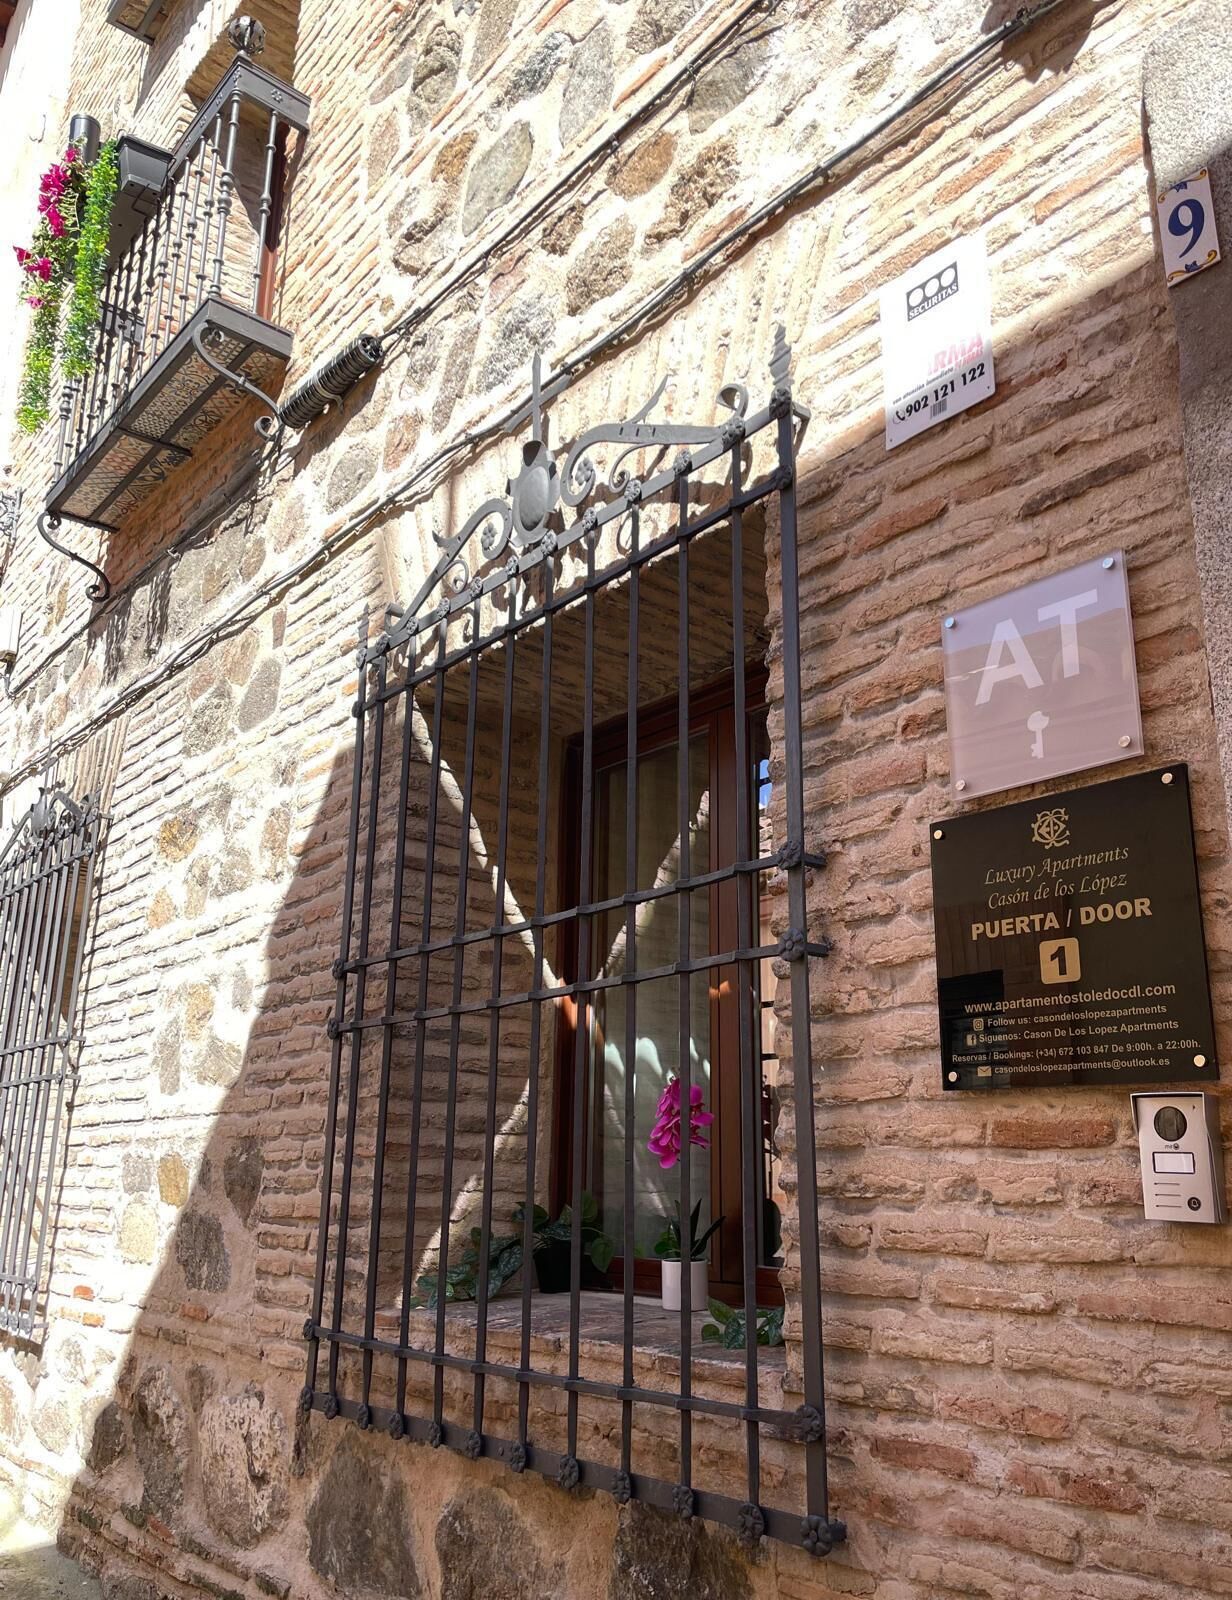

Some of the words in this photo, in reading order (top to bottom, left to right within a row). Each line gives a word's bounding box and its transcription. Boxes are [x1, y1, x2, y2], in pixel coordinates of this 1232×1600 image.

[1167, 198, 1206, 259] 9
[909, 282, 958, 319] SECURITAS
[905, 395, 929, 417] 902
[933, 379, 955, 401] 121
[961, 362, 985, 386] 122
[974, 588, 1098, 706] AT
[984, 864, 1036, 885] Luxury
[1037, 847, 1129, 878] Apartments
[988, 887, 1029, 910] Casón
[1033, 881, 1050, 900] de
[1054, 878, 1075, 897] los
[1079, 872, 1128, 895] López
[971, 911, 1060, 941] PUERTA
[1066, 908, 1072, 928] /
[1079, 897, 1153, 925] DOOR
[1050, 945, 1068, 976] 1
[964, 984, 1176, 1013] www.apartamentostoledocdl.com
[987, 1017, 1015, 1027] Follow
[1017, 1016, 1032, 1025] us:
[1033, 1004, 1167, 1023] casondeloslopezapartments
[1023, 1030, 1052, 1039] Cason
[1054, 1028, 1067, 1037] De
[1069, 1026, 1087, 1036] Los
[1088, 1025, 1119, 1036] Lopez
[1120, 1020, 1179, 1034] Apartments
[952, 1053, 987, 1063] Reservas
[993, 1049, 1034, 1060] Bookings:
[1035, 1047, 1057, 1058] (+34)
[1058, 1047, 1074, 1056] 672
[1076, 1046, 1091, 1055] 103
[1093, 1045, 1109, 1054] 847
[1111, 1044, 1124, 1053] De
[1126, 1042, 1155, 1052] 9:00h.
[1165, 1039, 1201, 1050] 22:00h.
[994, 1057, 1170, 1074] casondeloslopezapartments@outlook.es
